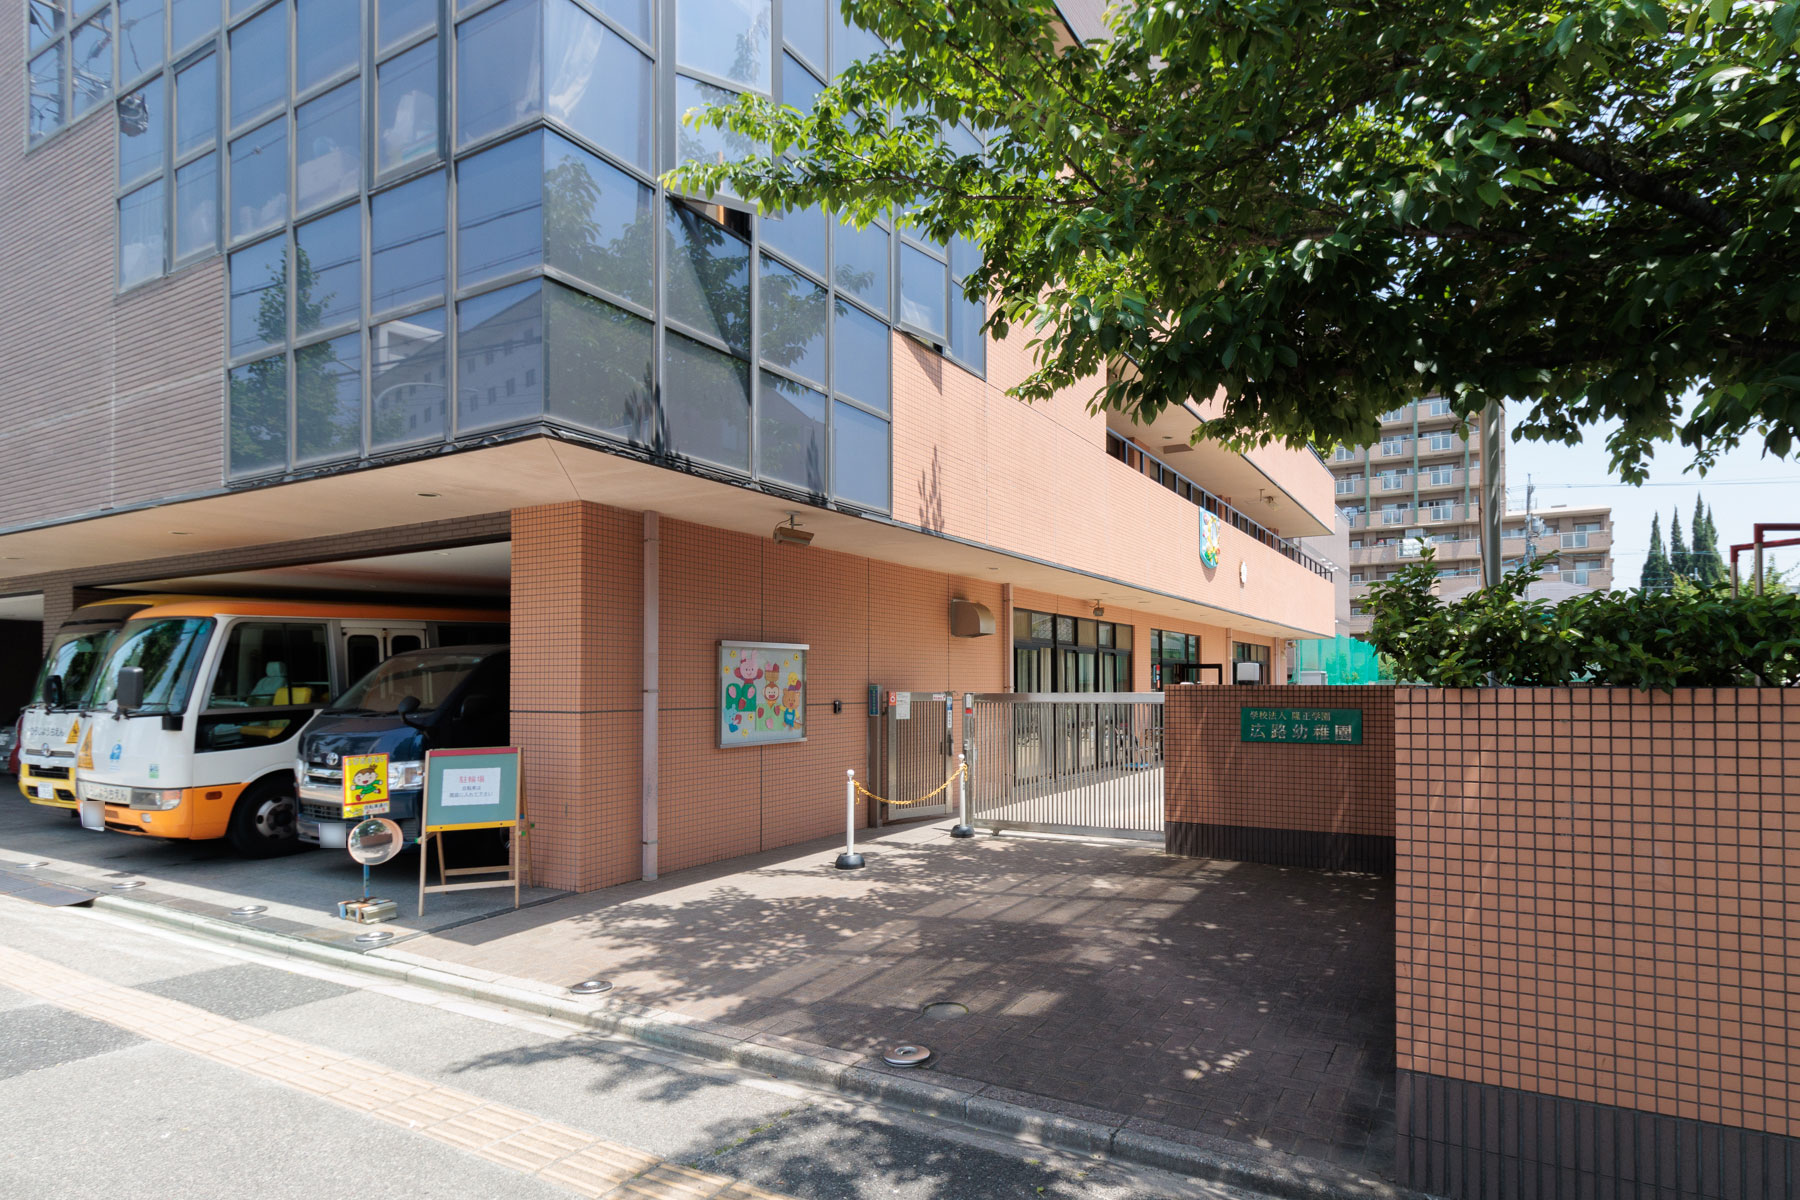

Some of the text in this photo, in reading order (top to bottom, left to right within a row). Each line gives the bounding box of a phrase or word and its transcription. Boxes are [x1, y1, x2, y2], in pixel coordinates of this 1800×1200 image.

[1250, 723, 1352, 742] 広路幼稚園
